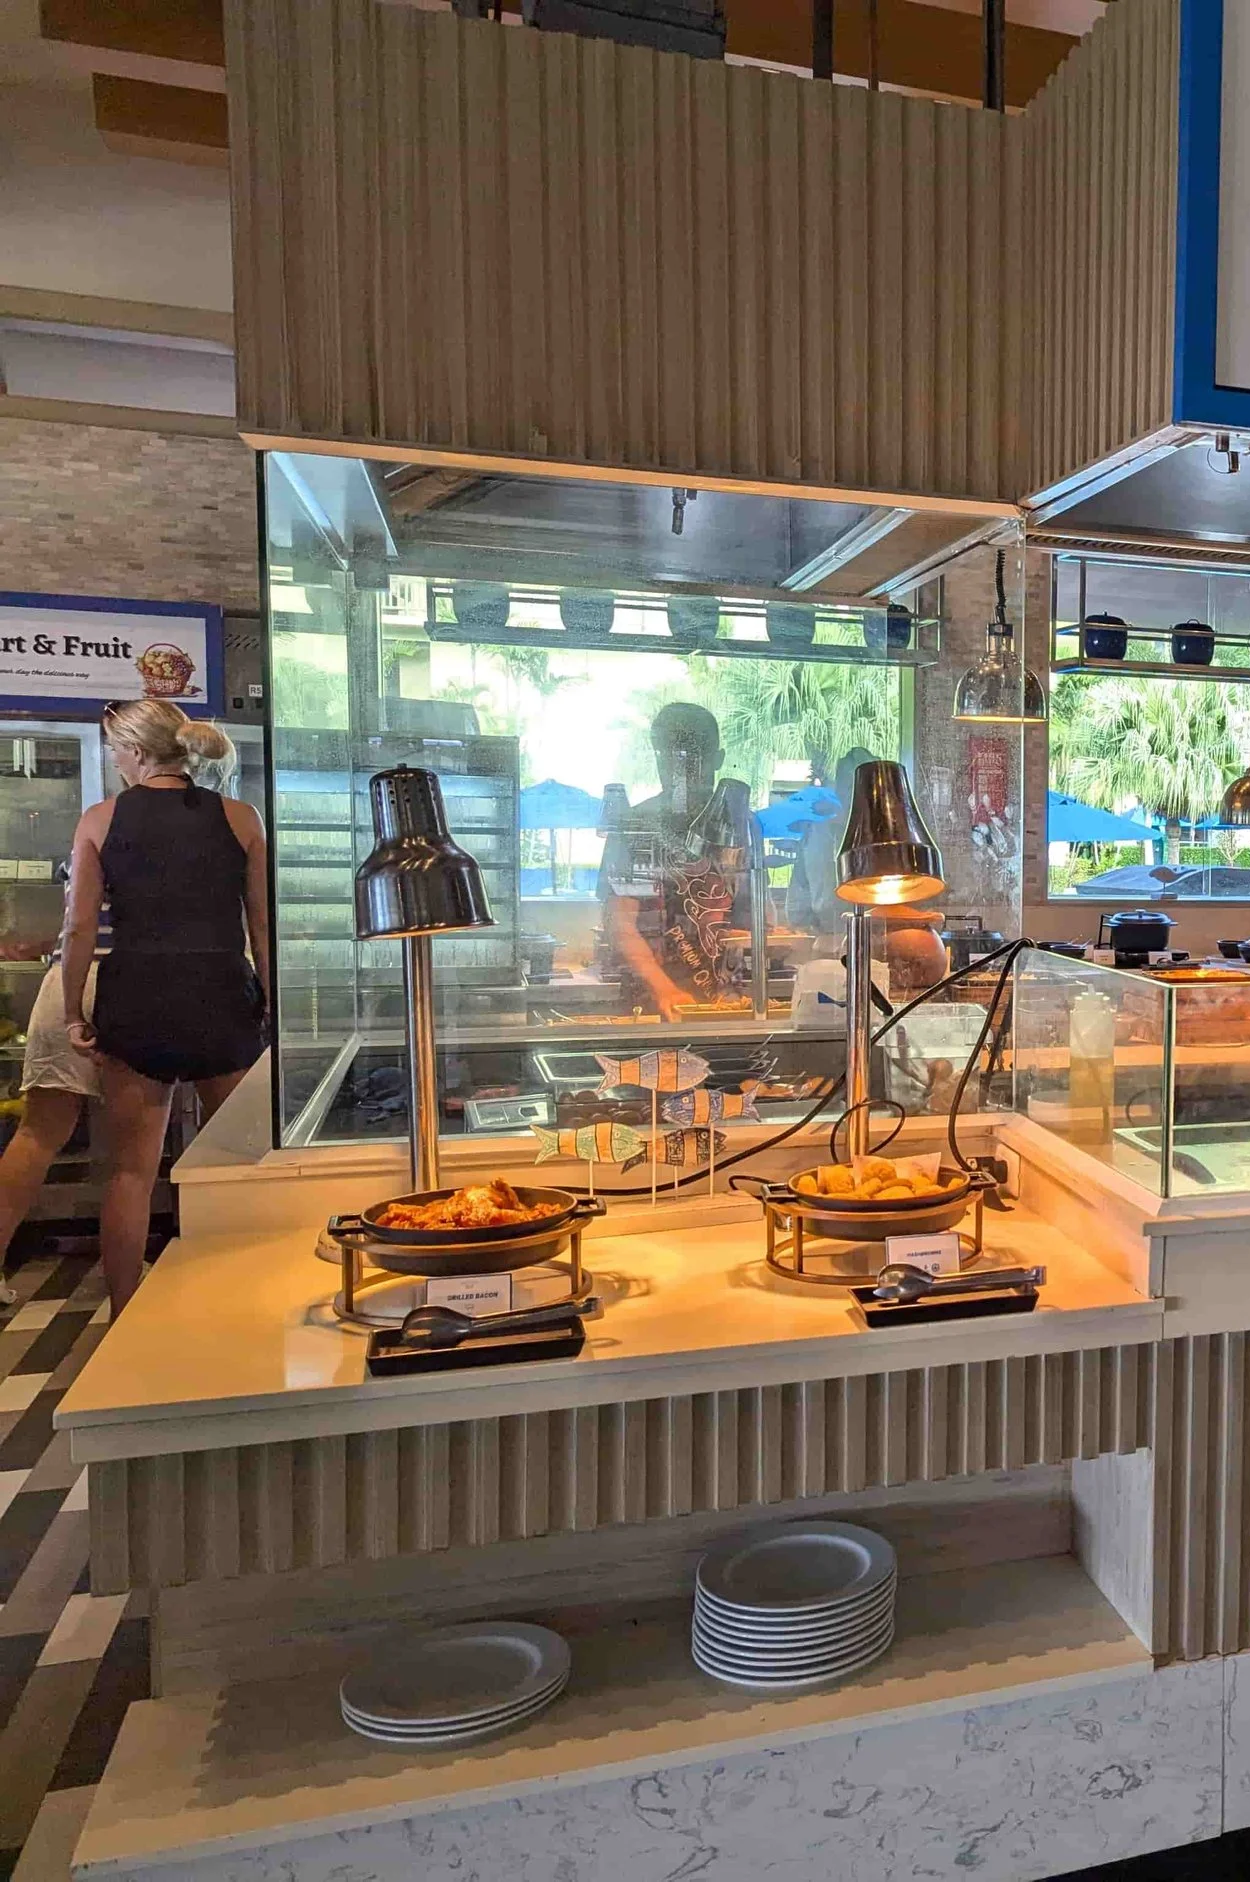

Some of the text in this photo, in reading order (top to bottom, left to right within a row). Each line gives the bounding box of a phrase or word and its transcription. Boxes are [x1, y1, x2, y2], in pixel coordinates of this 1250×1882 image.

[0, 634, 133, 660] rt & Fruit
